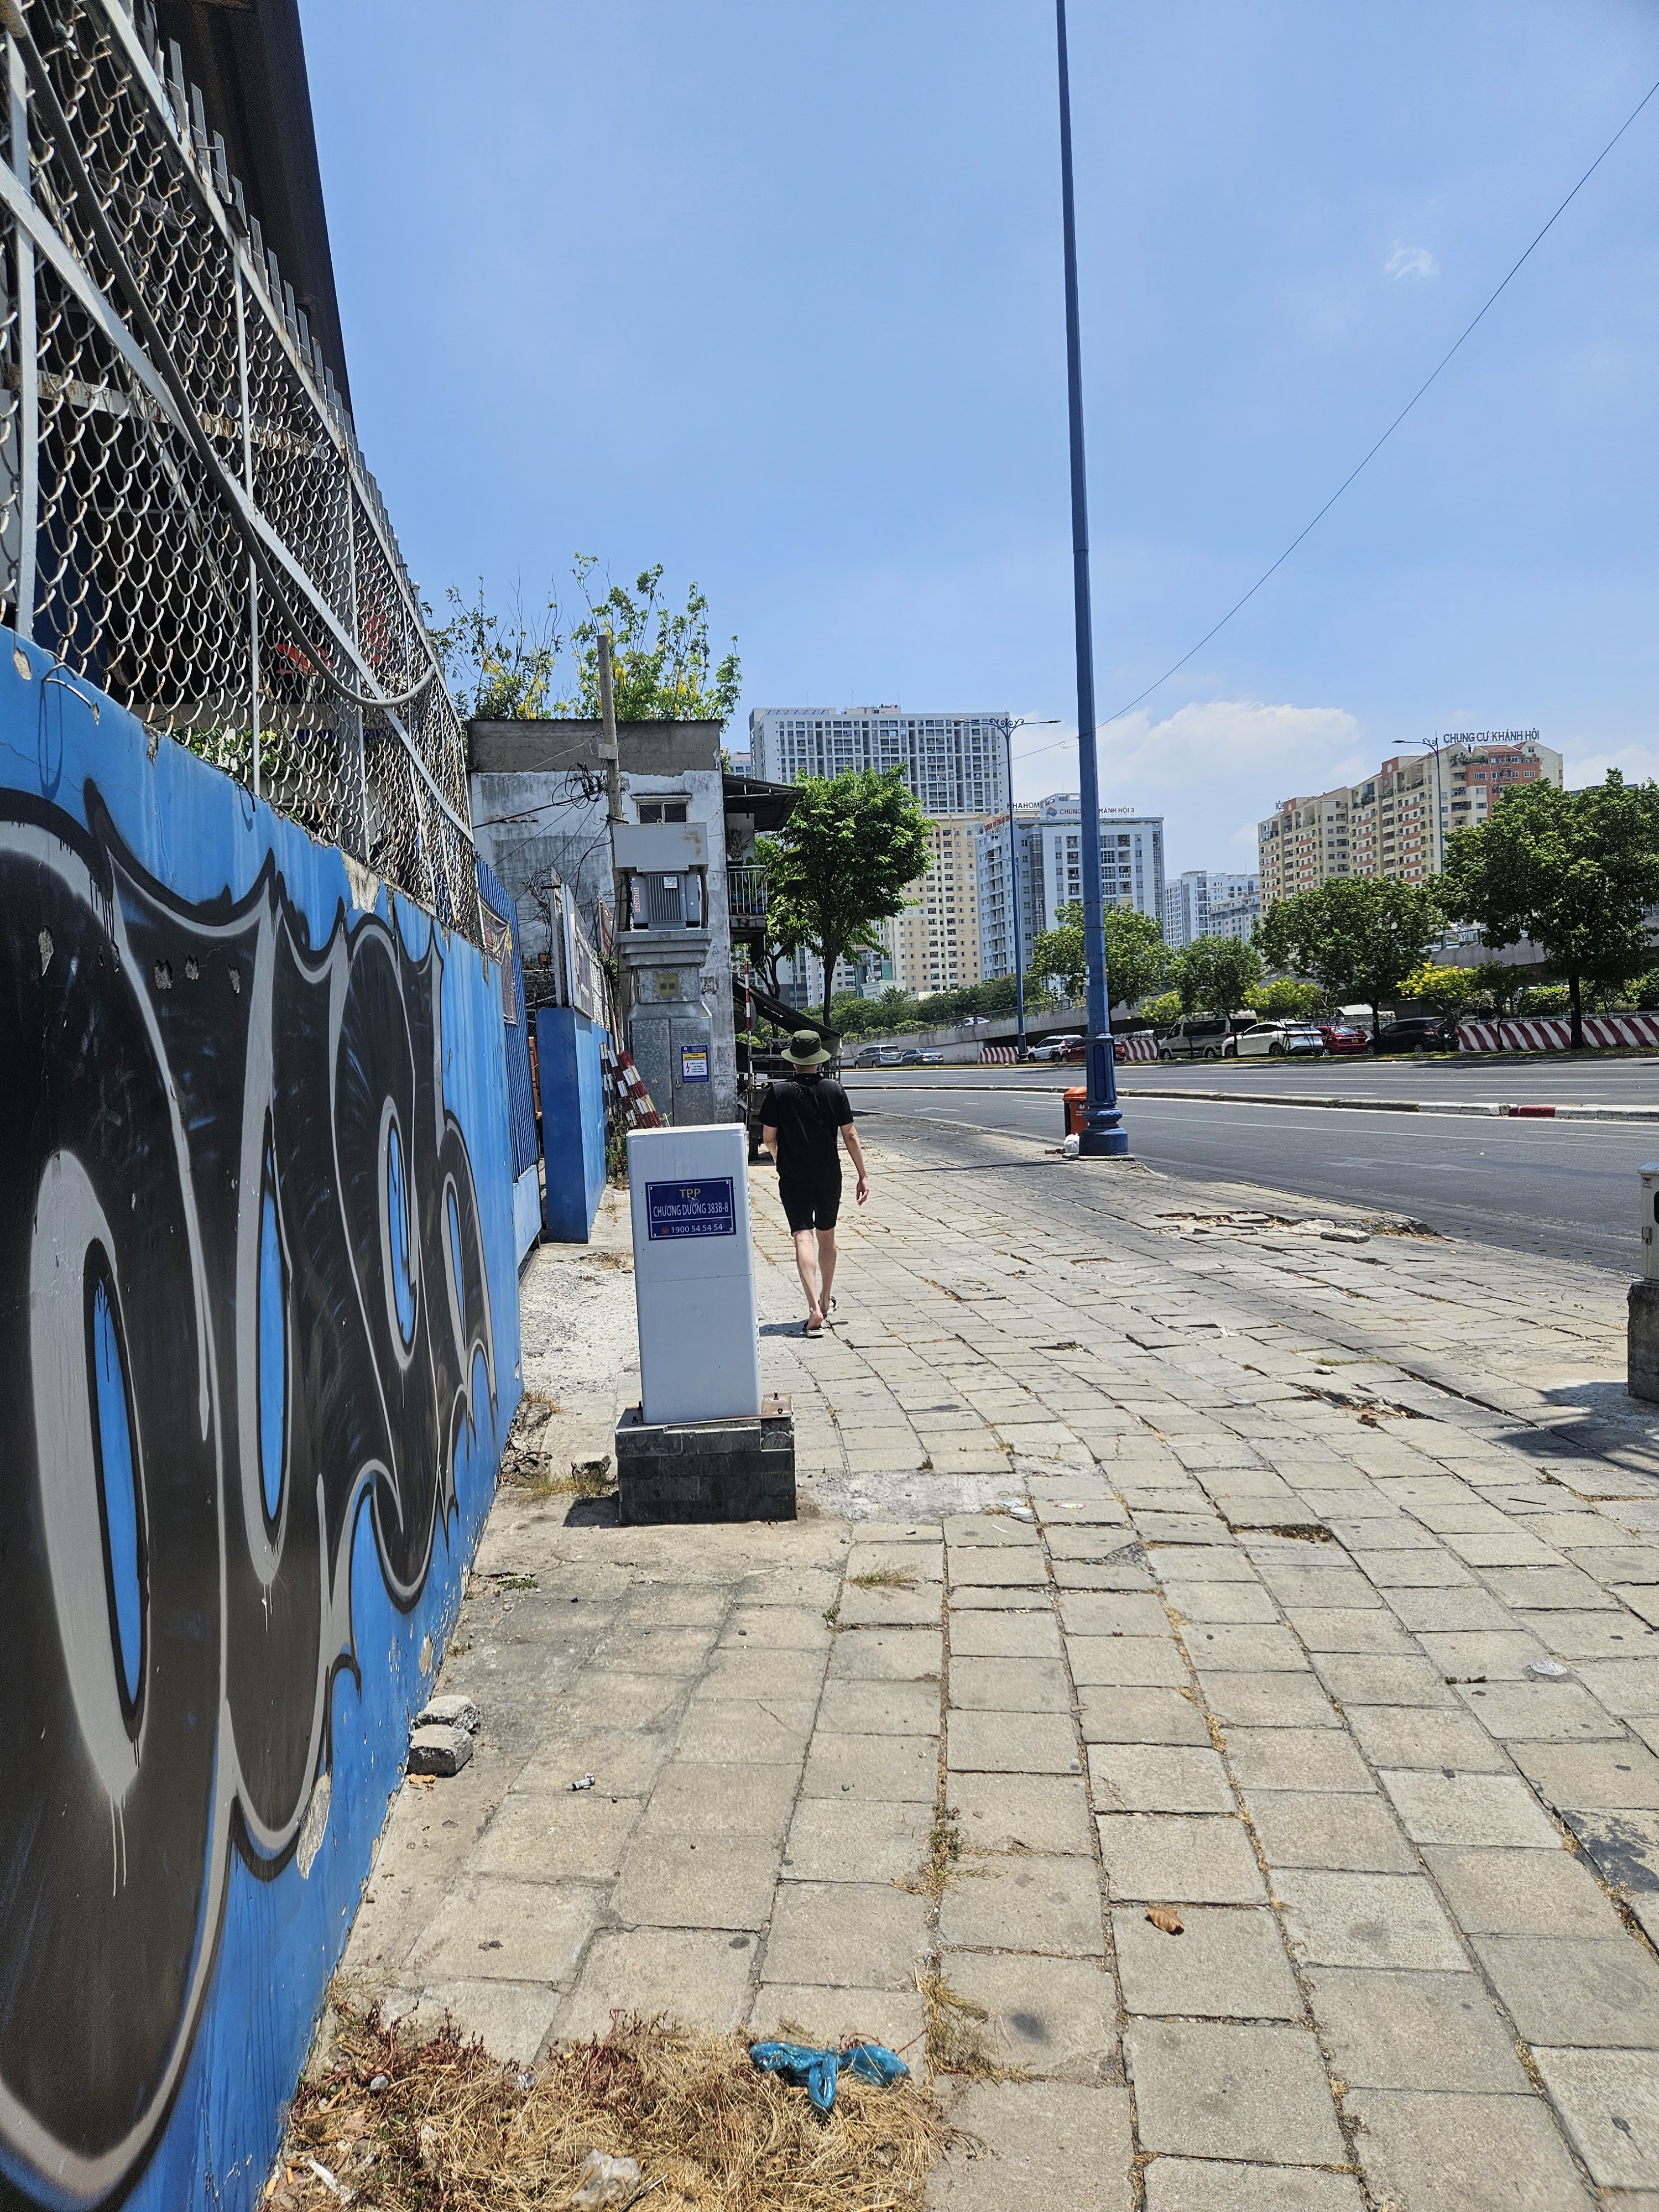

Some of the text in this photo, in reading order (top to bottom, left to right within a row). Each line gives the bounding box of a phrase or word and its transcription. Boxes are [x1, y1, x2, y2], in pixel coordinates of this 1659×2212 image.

[1443, 733, 1475, 743] CHUNG
[1477, 731, 1489, 742] CƯ
[1492, 728, 1522, 741] KHÁNH
[679, 1188, 701, 1198] TPP
[653, 1204, 681, 1217] CHƯƠNG
[707, 1202, 729, 1214] 383B-8
